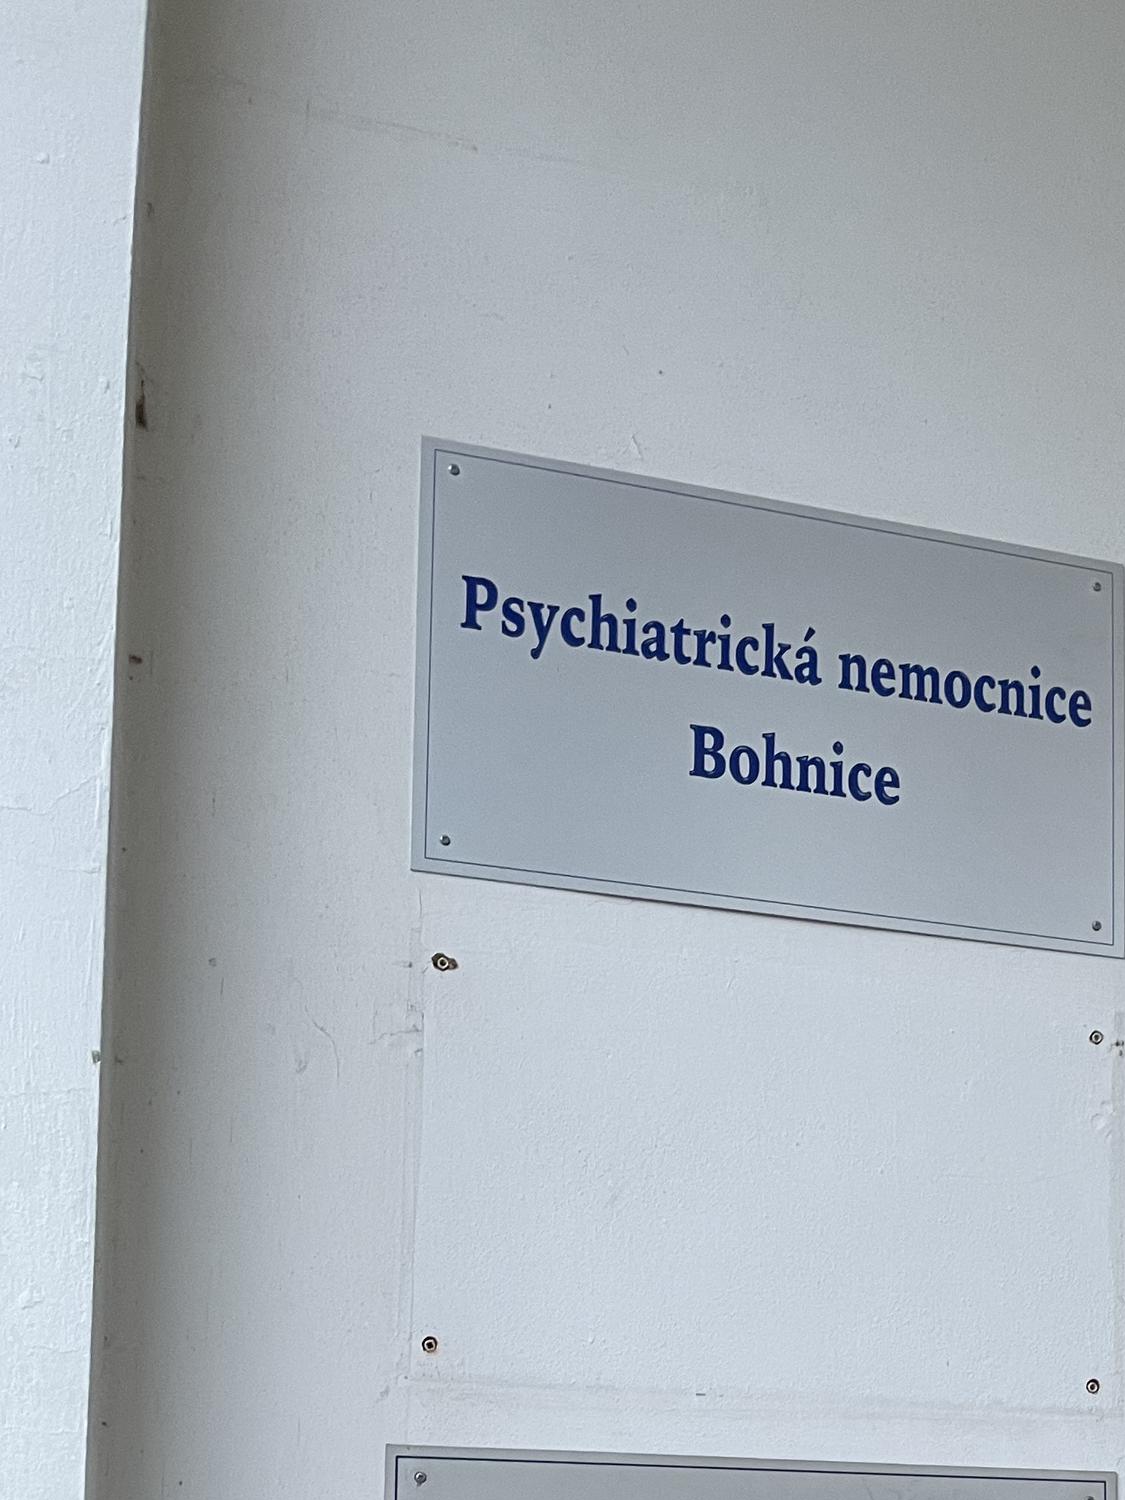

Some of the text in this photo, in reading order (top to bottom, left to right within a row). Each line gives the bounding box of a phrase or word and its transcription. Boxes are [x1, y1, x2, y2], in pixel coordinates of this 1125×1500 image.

[460, 574, 1092, 728] Psychiatrická nemocnice
[688, 723, 901, 806] Bohnice
